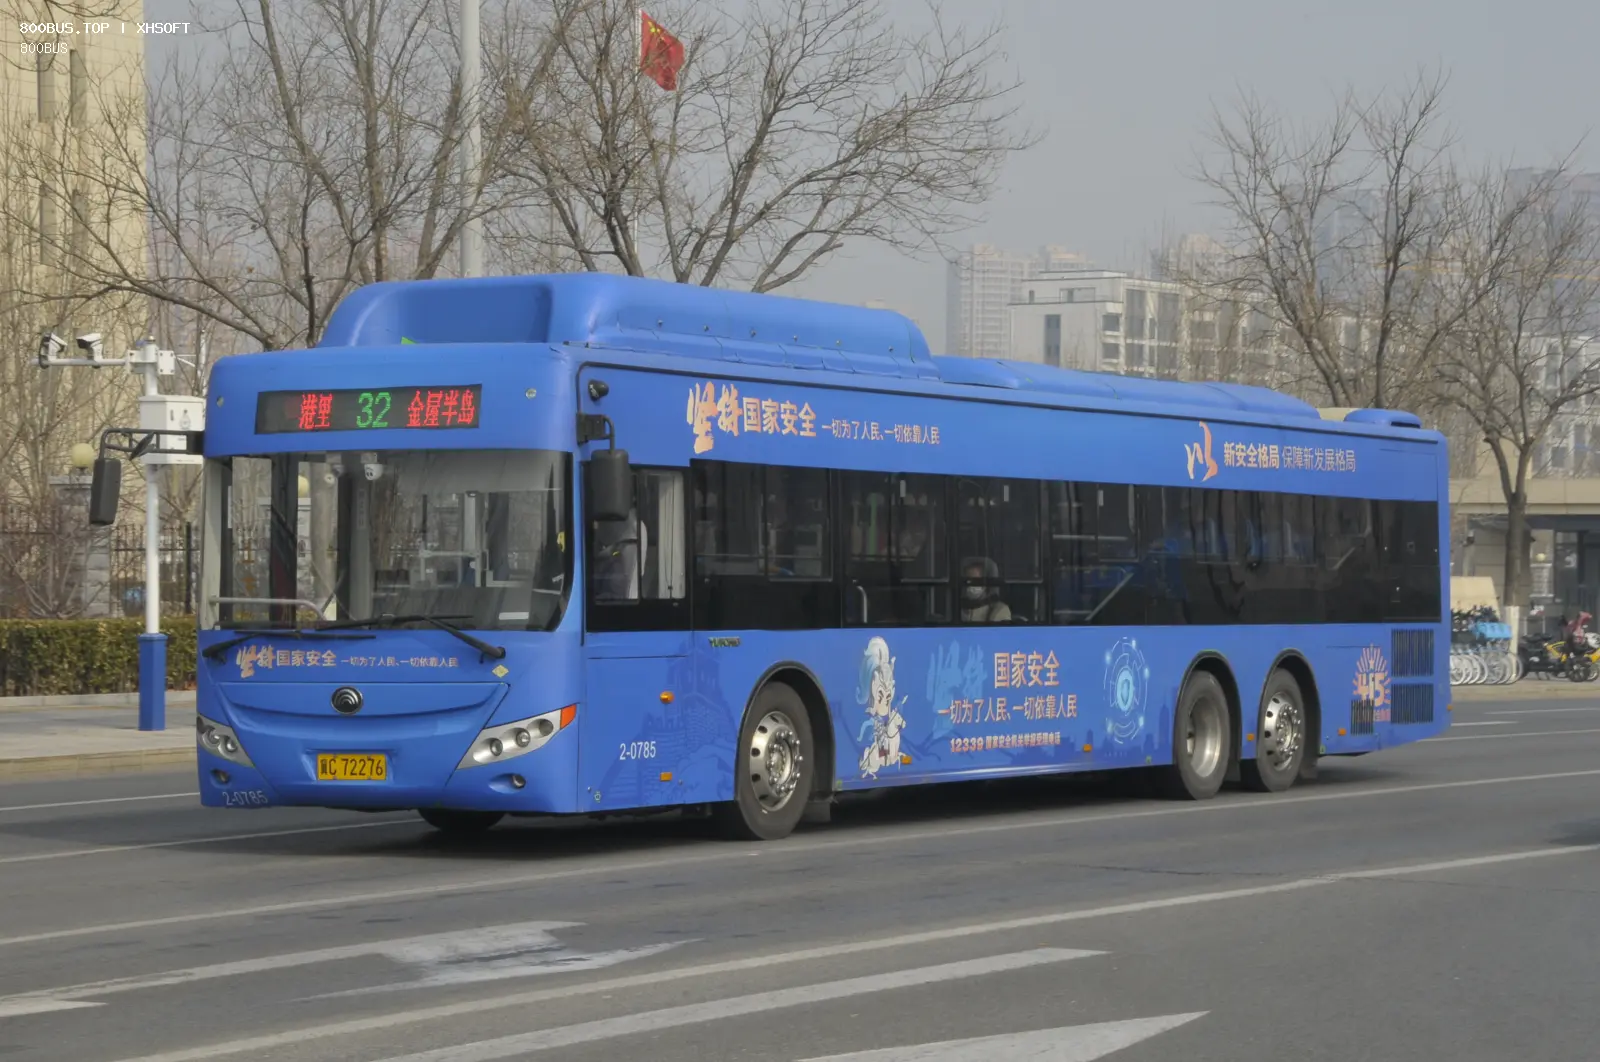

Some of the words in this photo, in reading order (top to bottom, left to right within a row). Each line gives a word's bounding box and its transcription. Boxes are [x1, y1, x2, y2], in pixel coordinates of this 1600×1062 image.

[356, 392, 392, 428] 32
[821, 419, 941, 445] 一切为了人民、一切依靠人民
[1223, 441, 1280, 469] 新安全格局
[1281, 446, 1356, 473] 保障新发展格局
[341, 656, 458, 668] 一切为了人民、一切依靠人民
[993, 650, 1060, 689] 国家安全
[938, 694, 1078, 725] 一切为了人民、一切依靠人民
[619, 741, 657, 760] 2-0785
[950, 737, 984, 753] 12339
[222, 790, 269, 806] 2-0785
